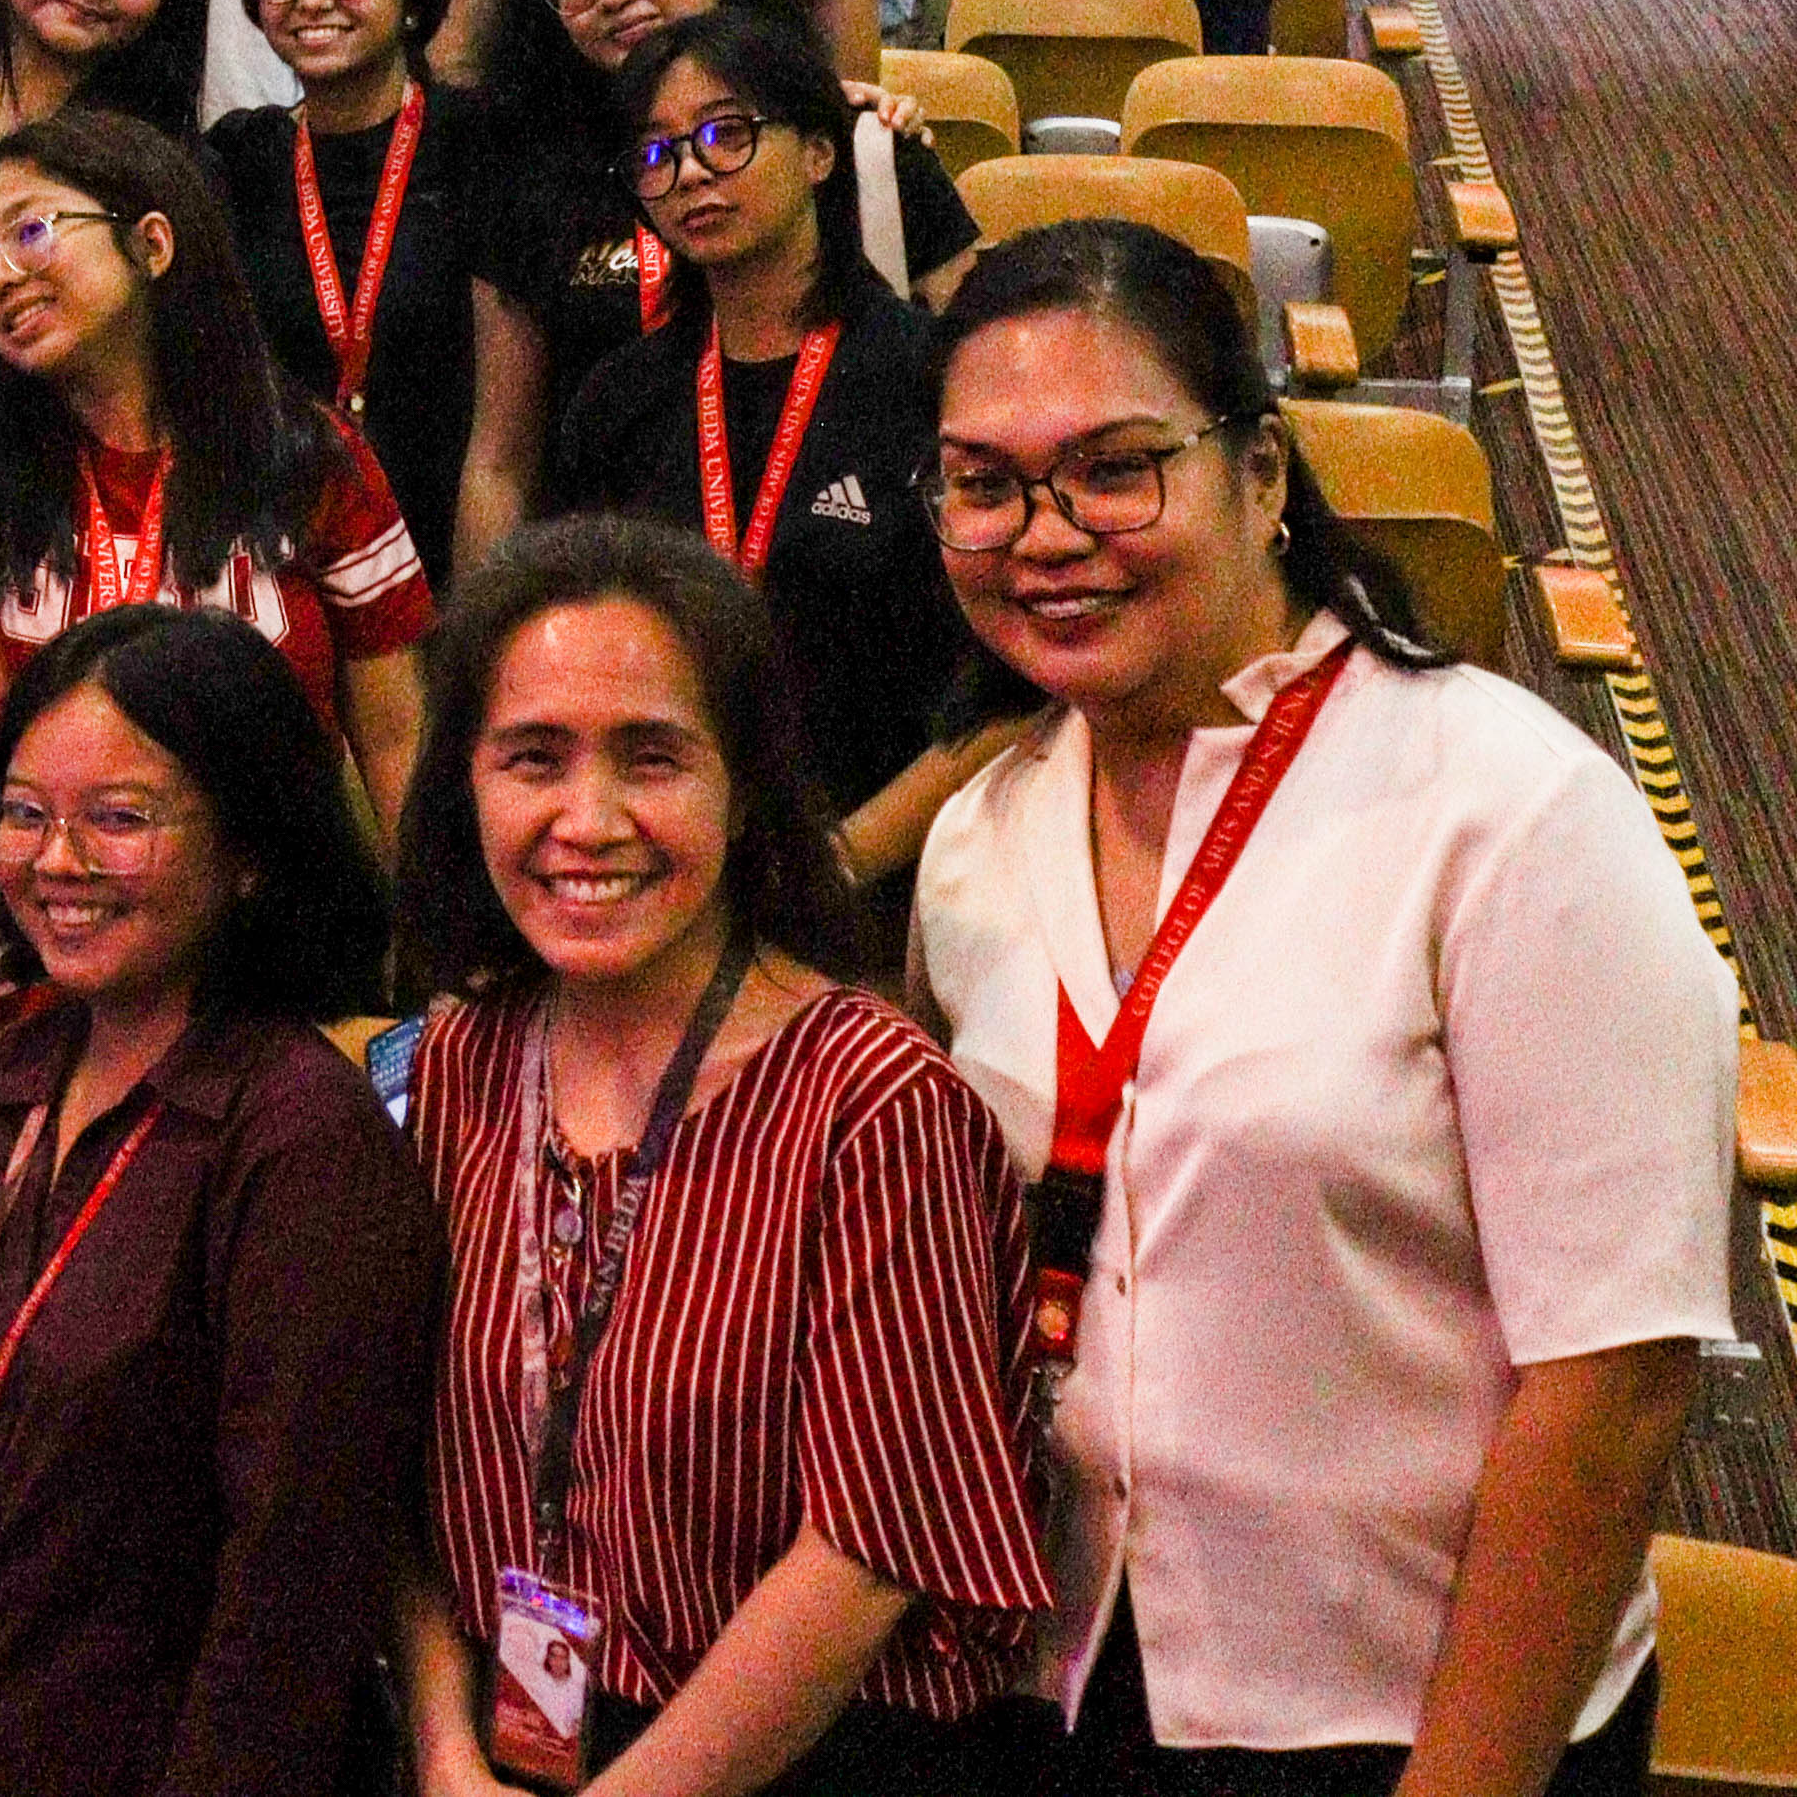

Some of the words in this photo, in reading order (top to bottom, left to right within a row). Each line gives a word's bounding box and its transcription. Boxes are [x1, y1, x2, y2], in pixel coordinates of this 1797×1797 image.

[387, 122, 414, 186] SCIENCES
[301, 183, 320, 229] BEDA
[380, 187, 395, 218] AND
[365, 258, 379, 275] OF
[371, 220, 389, 252] ARTS
[309, 232, 345, 340] UNIVERSITY
[354, 274, 374, 340] COLLEGE
[702, 393, 721, 452] BEDA
[766, 451, 789, 491] ARTS
[781, 409, 801, 446] AND
[792, 335, 826, 410] SCIENCES
[810, 501, 871, 525] adidas
[95, 520, 118, 608] UNIVERS
[1131, 917, 1189, 1018] COLLEGE
